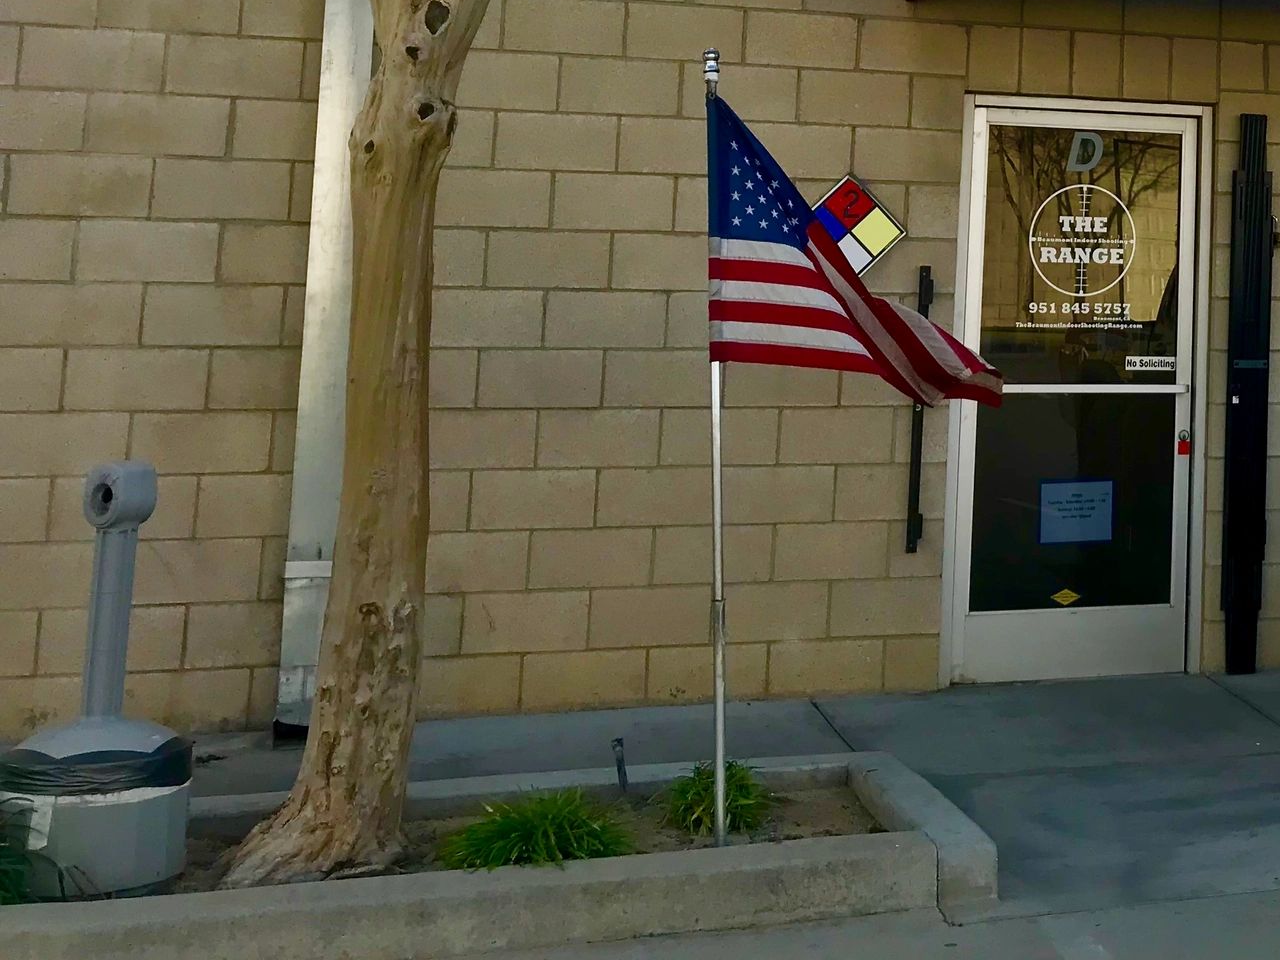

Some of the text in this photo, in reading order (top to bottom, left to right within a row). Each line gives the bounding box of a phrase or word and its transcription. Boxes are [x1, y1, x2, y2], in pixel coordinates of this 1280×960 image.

[1066, 131, 1104, 172] D
[843, 189, 862, 218] 2
[1059, 215, 1108, 233] THE
[1039, 246, 1124, 265] RANGE
[1028, 302, 1131, 315] 951 845 5757
[1015, 322, 1143, 330] TheBeaumontIndoorShootingRange.com
[1126, 358, 1175, 370] No Soliciting
